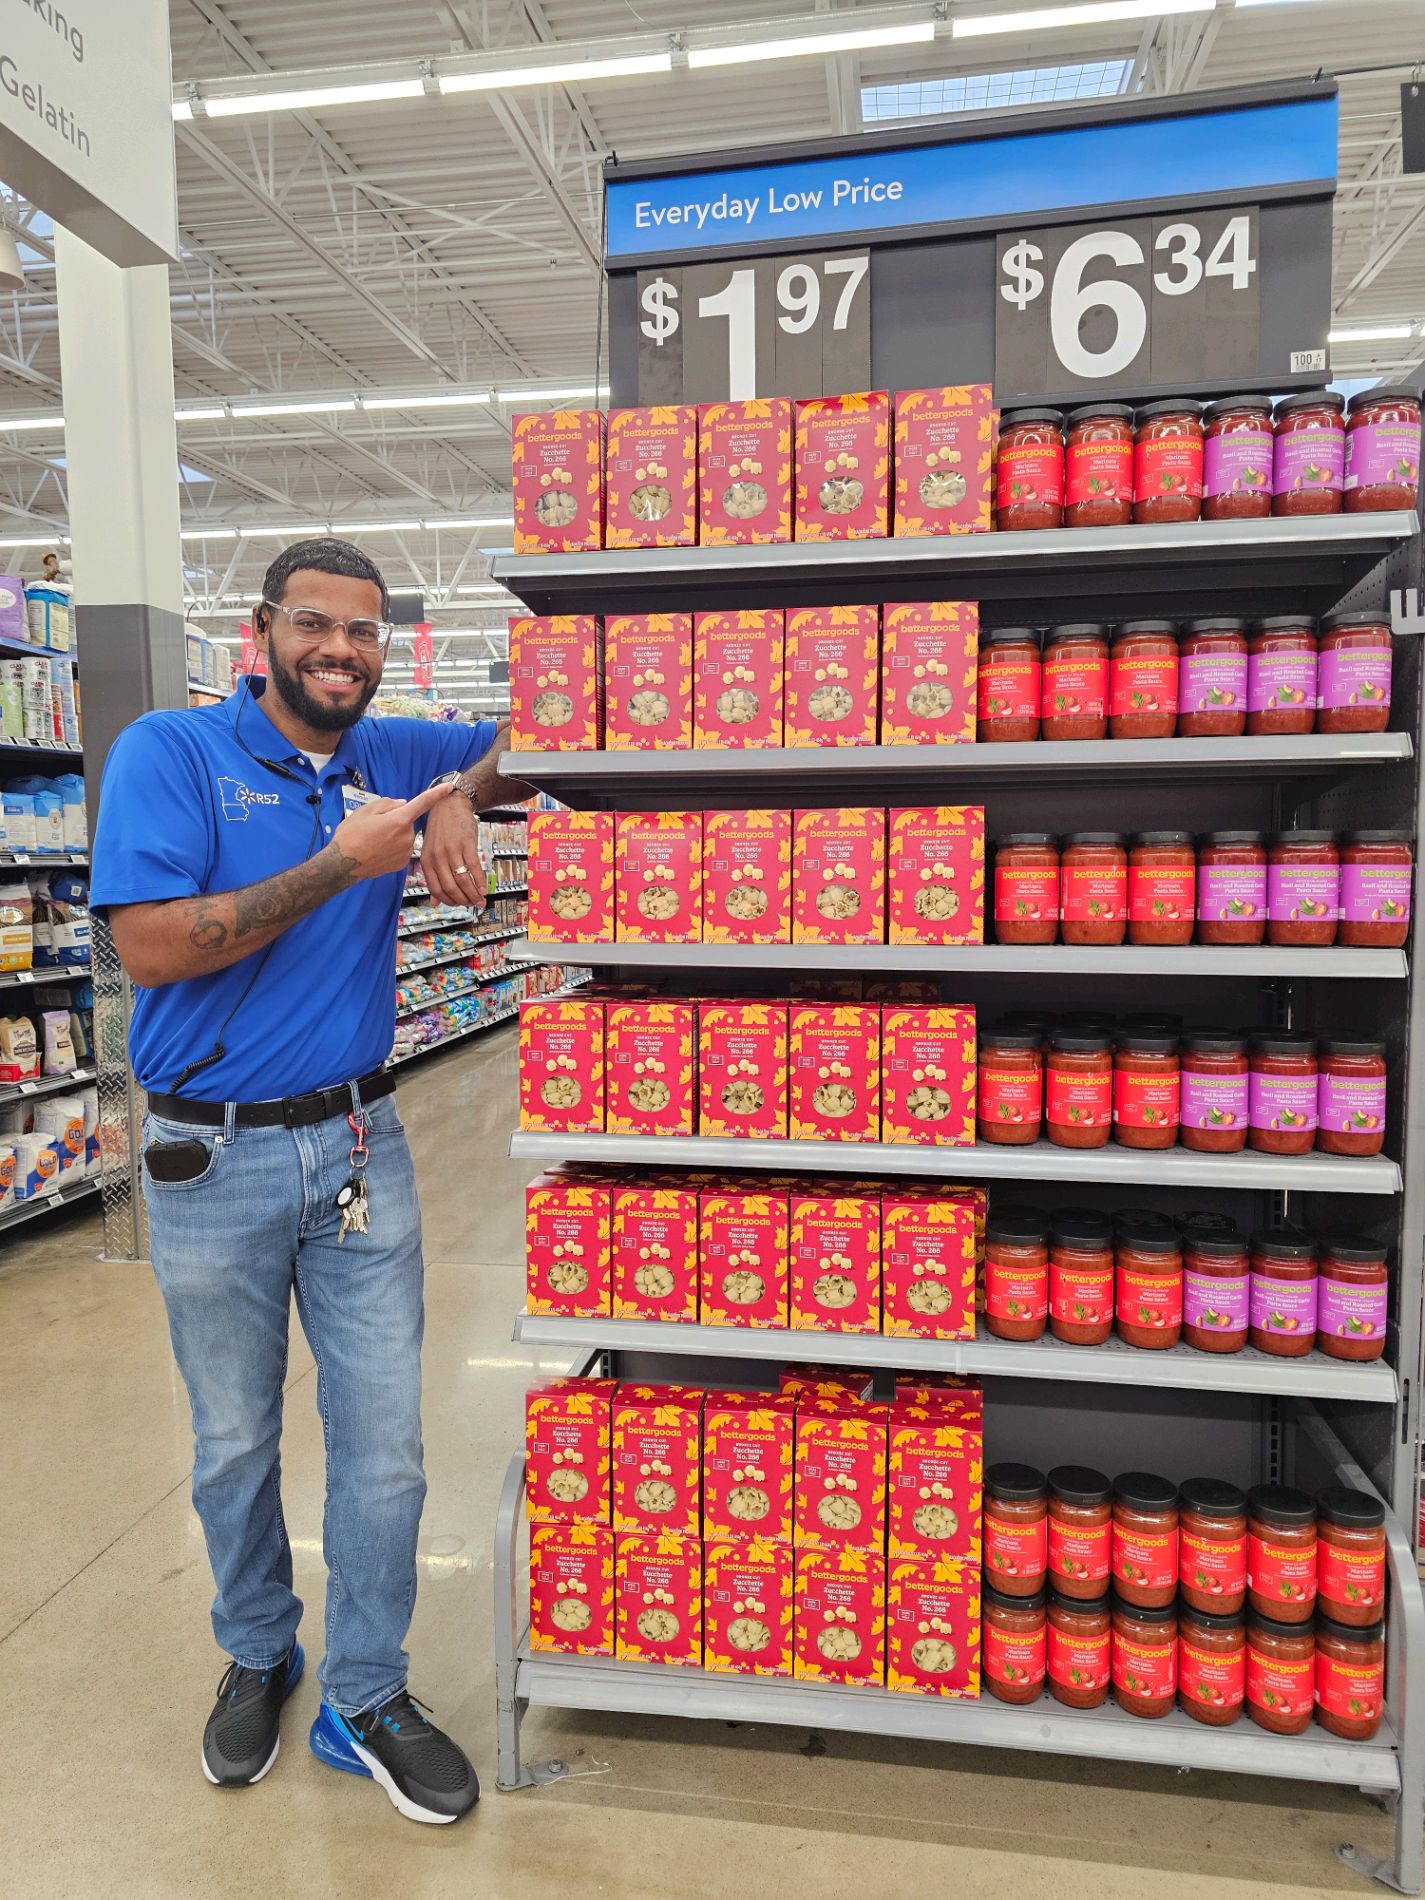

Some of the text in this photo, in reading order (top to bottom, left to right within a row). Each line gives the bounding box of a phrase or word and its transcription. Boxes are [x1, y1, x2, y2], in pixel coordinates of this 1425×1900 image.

[21, 0, 84, 63] king
[0, 55, 91, 157] Gelatin
[636, 178, 902, 229] Everyday Low Price
[1294, 353, 1313, 366] 100
[912, 408, 974, 421] bettergoods
[715, 420, 774, 433] bettergoods
[811, 415, 871, 429] bettergoods
[527, 431, 582, 443] bettergoods
[623, 427, 679, 438] bettergoods
[802, 627, 860, 638] bettergoods
[900, 623, 961, 634] bettergoods
[524, 636, 579, 646] bettergoods
[620, 634, 676, 645] bettergoods
[710, 631, 767, 641] bettergoods
[256, 793, 281, 805] R52
[542, 831, 597, 841] bettergoods
[631, 831, 686, 841] bettergoods
[718, 830, 775, 840] bettergoods
[809, 829, 868, 839] bettergoods
[906, 828, 967, 838] bettergoods
[534, 1022, 587, 1032] bettergoods
[621, 1024, 676, 1034] bettergoods
[714, 1026, 770, 1036] bettergoods
[805, 1028, 862, 1038] bettergoods
[899, 1030, 958, 1040] bettergoods
[540, 1207, 594, 1218] bettergoods
[627, 1209, 681, 1220] bettergoods
[715, 1216, 771, 1226] bettergoods
[806, 1218, 863, 1229] bettergoods
[898, 1224, 957, 1235] bettergoods
[540, 1415, 594, 1425] bettergoods
[627, 1426, 682, 1437] bettergoods
[720, 1430, 777, 1442] bettergoods
[811, 1437, 869, 1451] bettergoods
[905, 1446, 965, 1459] bettergoods
[544, 1544, 598, 1556] bettergoods
[630, 1554, 685, 1566] bettergoods
[720, 1562, 776, 1574] bettergoods
[810, 1570, 869, 1584] bettergoods
[904, 1581, 964, 1594] bettergoods
